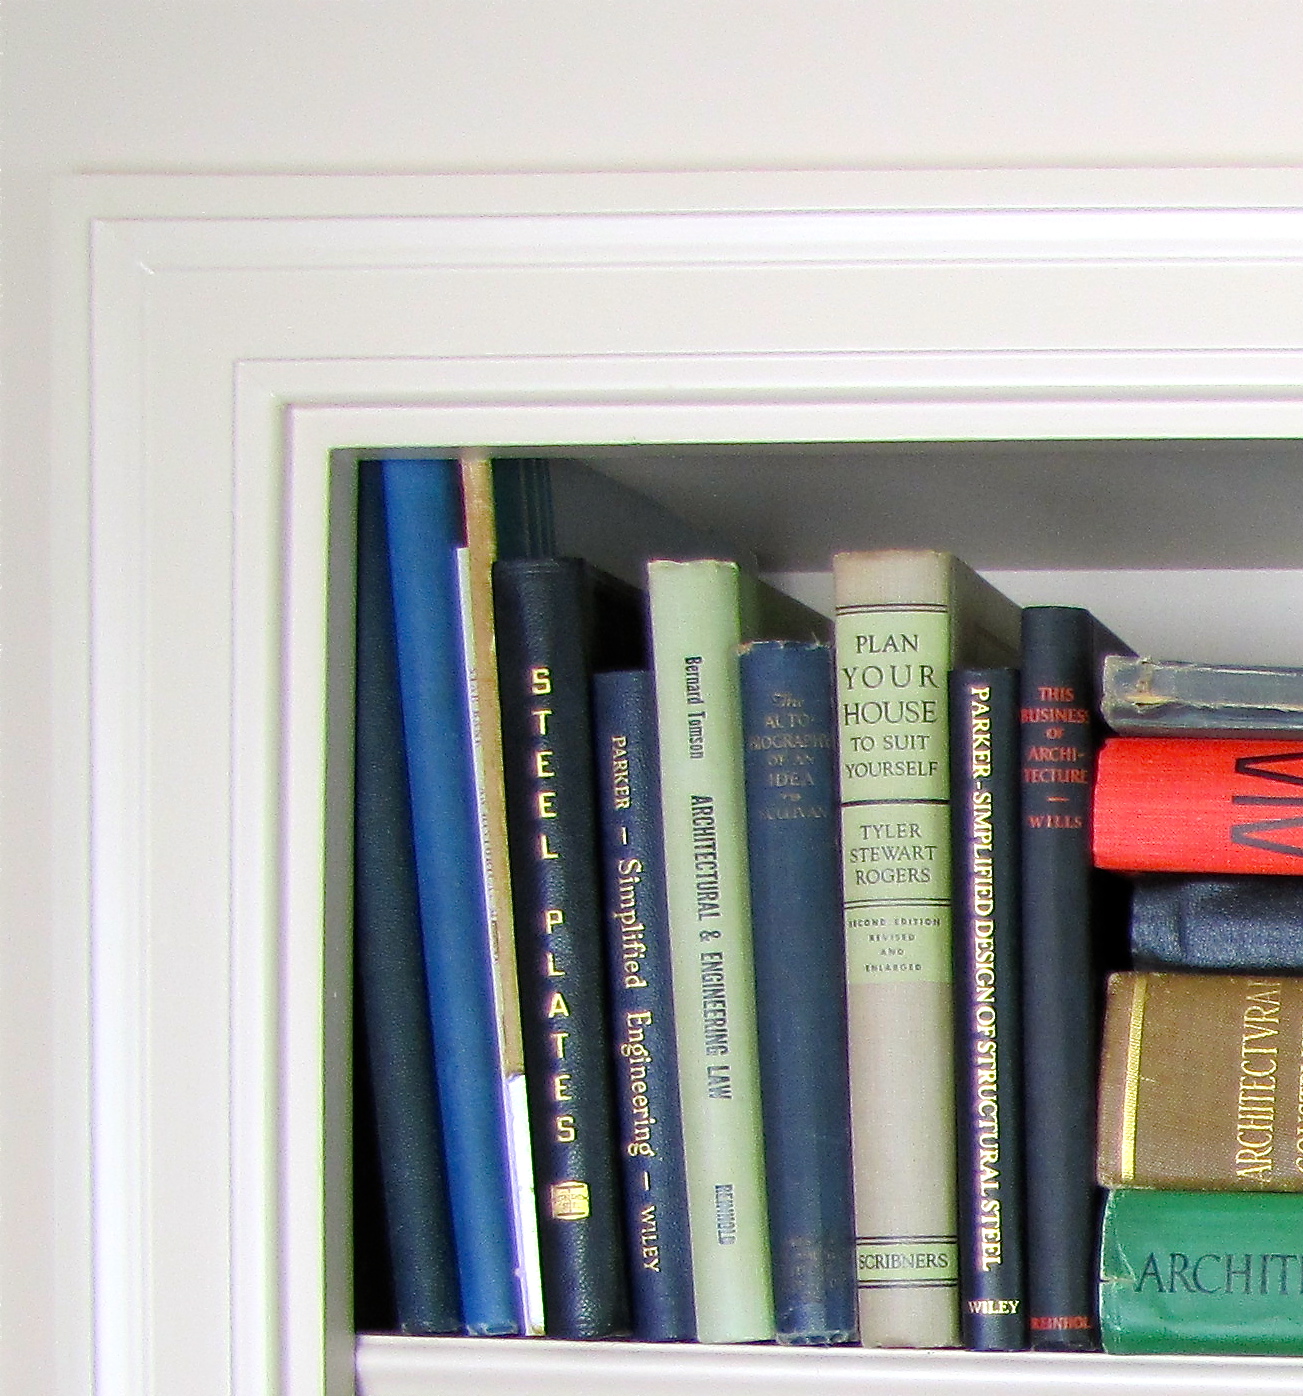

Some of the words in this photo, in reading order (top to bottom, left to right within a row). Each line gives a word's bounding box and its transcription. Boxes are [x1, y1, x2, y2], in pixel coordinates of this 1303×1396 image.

[855, 634, 920, 655] PLAN
[683, 655, 705, 705] Bernard
[842, 664, 940, 690] YOUR
[1037, 686, 1075, 701] THIS
[843, 700, 938, 726] HOUSE
[850, 735, 875, 752] TO
[883, 734, 930, 751] SUIT
[530, 666, 559, 860] STEEL
[611, 735, 632, 810] PARKER
[845, 761, 938, 779] YOURSELF
[1023, 768, 1088, 784] TECTURE
[859, 823, 922, 840] TYLER
[690, 795, 723, 922] ARCHITECTURAL
[849, 845, 938, 864] STEWART
[971, 790, 995, 916] SIMPLIFIED
[855, 868, 931, 885] ROGERS
[613, 857, 648, 989] Simplified
[974, 919, 997, 1003] DESIGN
[700, 951, 730, 1057] ENGINEERING
[543, 909, 577, 1143] PLATES
[620, 1010, 656, 1157] Engineering
[975, 1038, 1000, 1196] STRUCTURAL
[980, 1197, 1004, 1273] STEEL
[858, 1252, 949, 1271] SCRIBNERS
[967, 1299, 1020, 1315] WILEY
